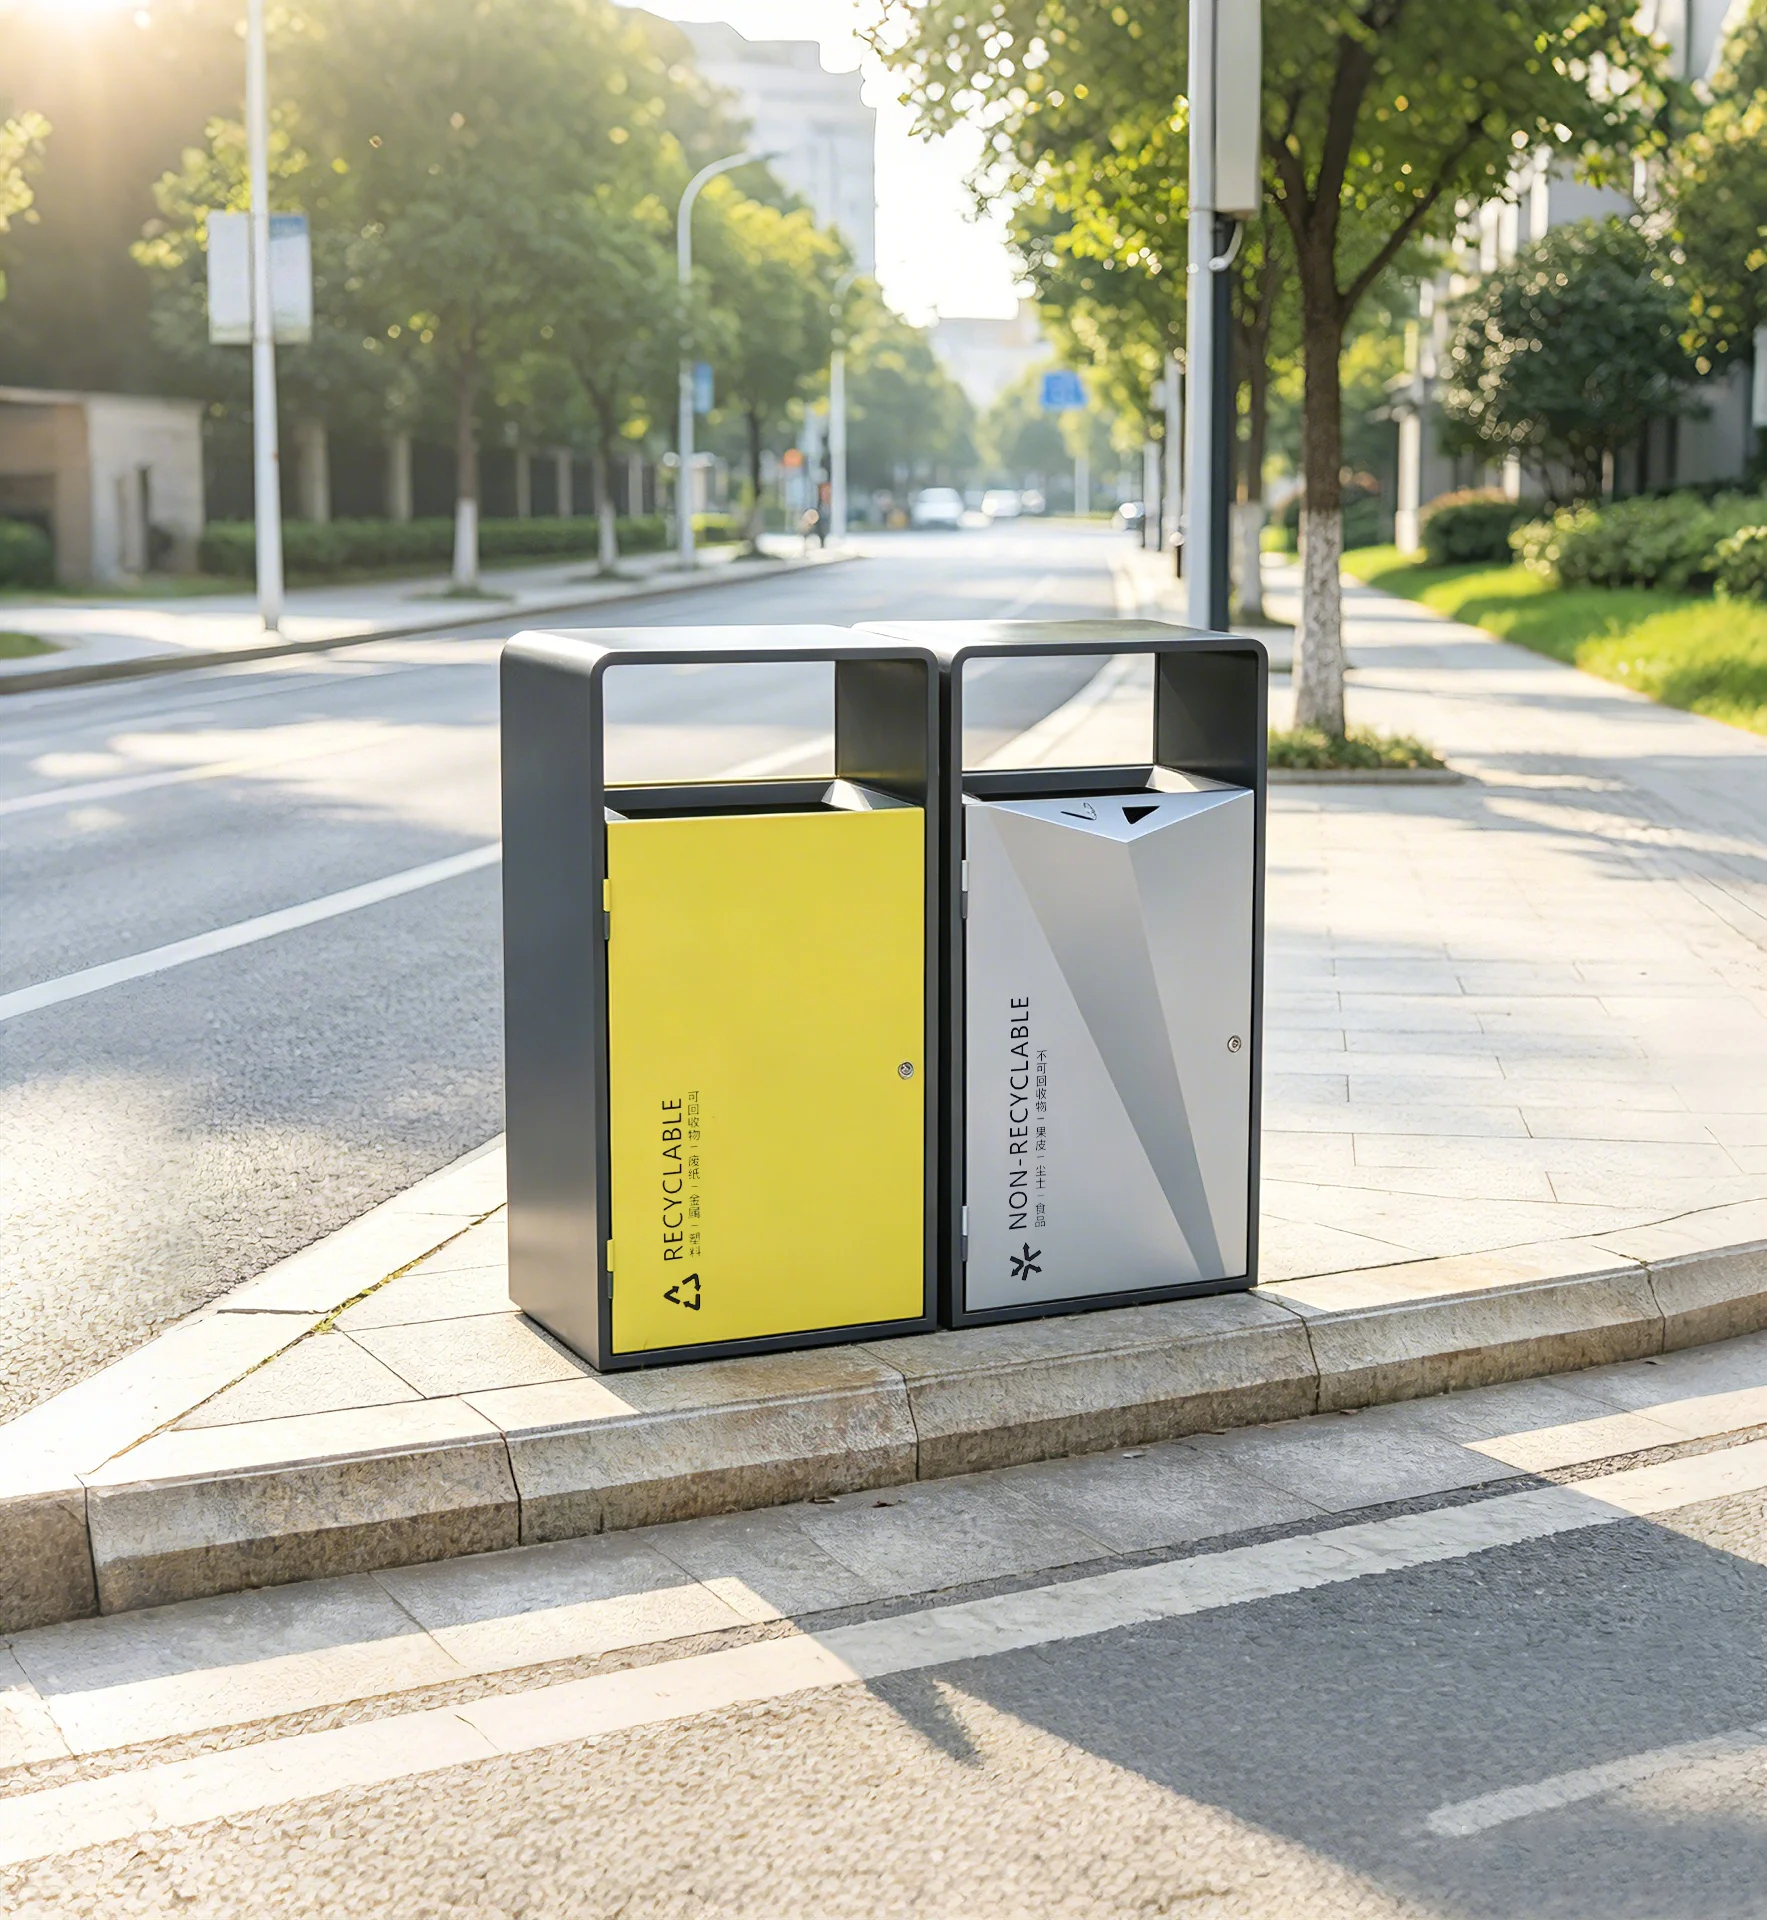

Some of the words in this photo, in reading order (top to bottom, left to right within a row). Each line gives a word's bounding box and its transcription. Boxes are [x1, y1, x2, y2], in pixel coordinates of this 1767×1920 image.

[1009, 996, 1029, 1230] NON-RECYCLABLE
[1035, 1049, 1048, 1113] 不可回收物
[687, 1090, 701, 1141] 可回收物
[1035, 1126, 1047, 1152] 果皮
[661, 1098, 683, 1261] RECYCLABLE
